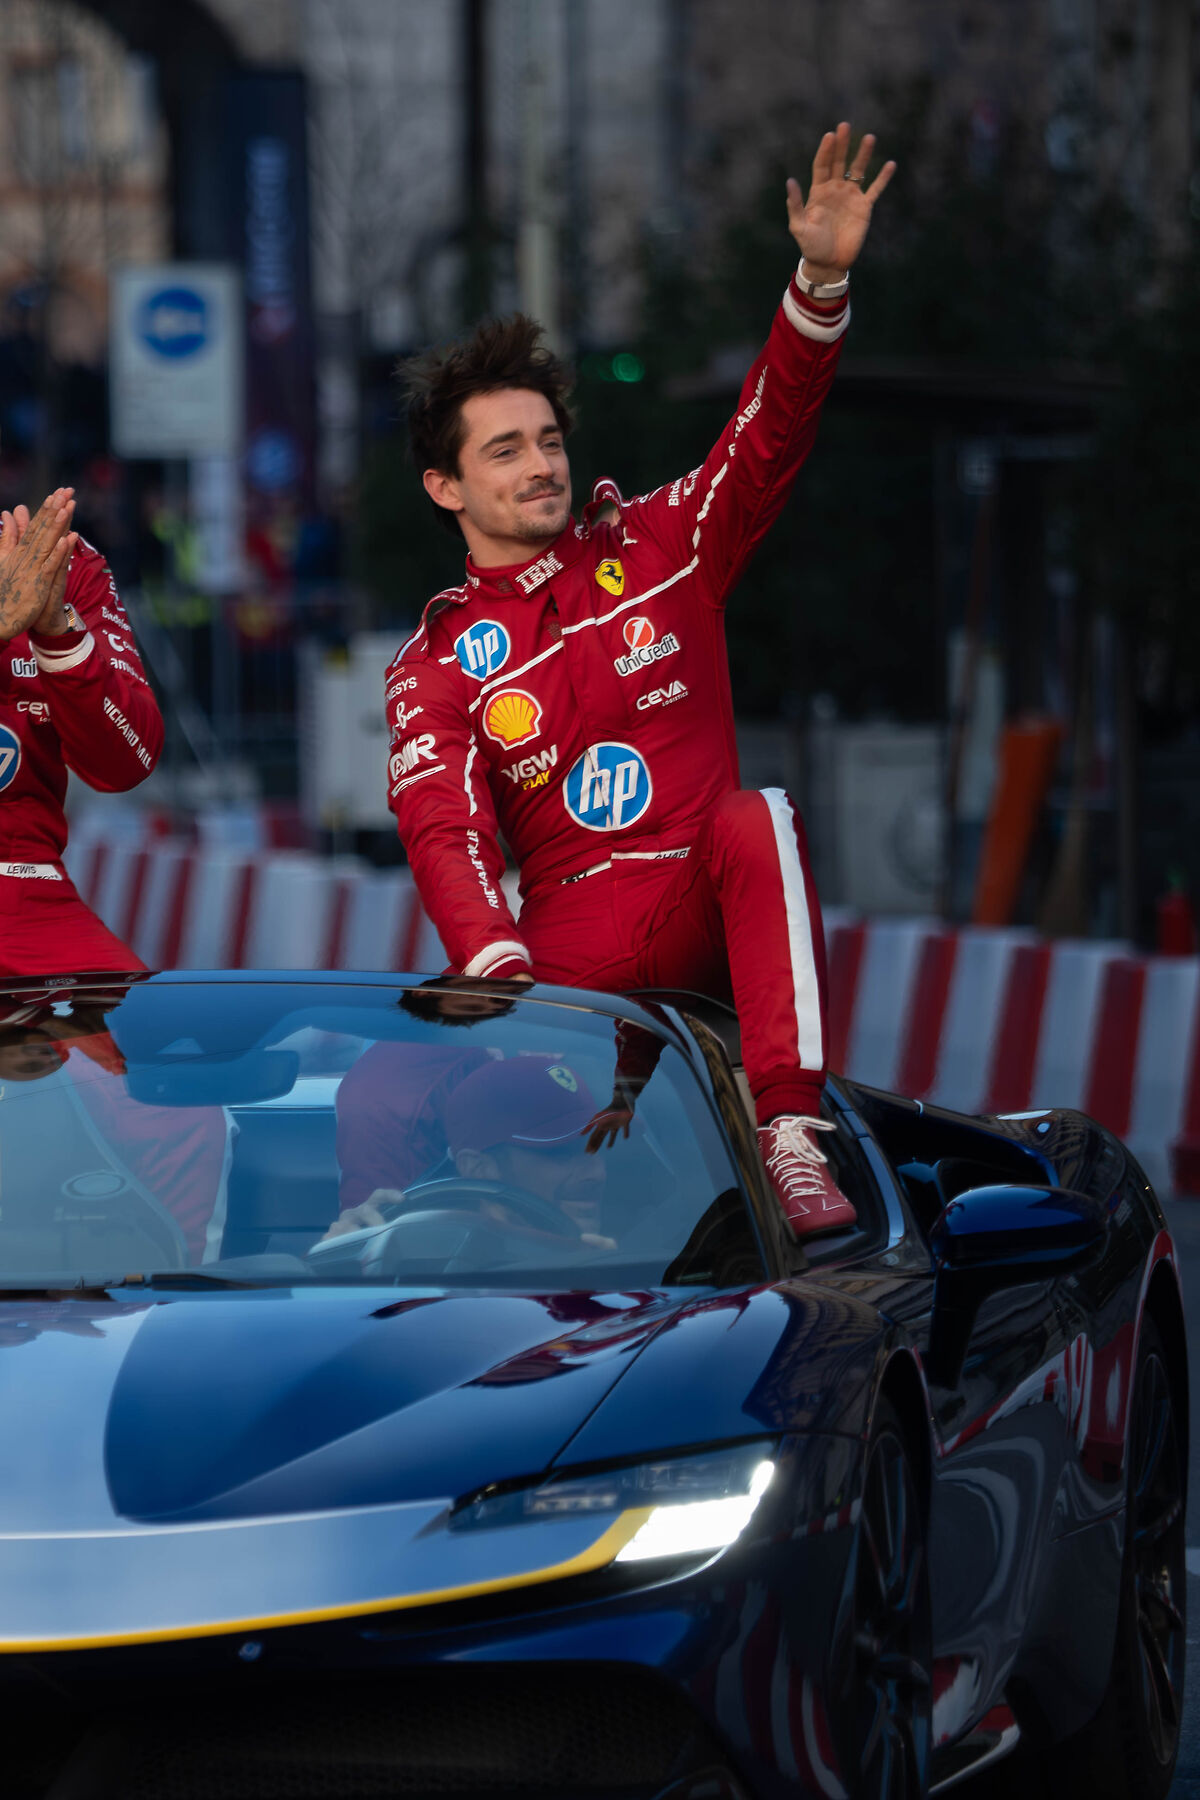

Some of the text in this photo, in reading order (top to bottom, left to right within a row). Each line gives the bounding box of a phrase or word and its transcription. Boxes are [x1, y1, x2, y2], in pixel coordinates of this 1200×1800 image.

[515, 551, 564, 594] IBM
[616, 634, 677, 674] UniCredit
[103, 696, 140, 747] RICHARD
[500, 744, 558, 784] VGW
[521, 769, 550, 791] PLAY
[6, 865, 37, 875] LEWIS
